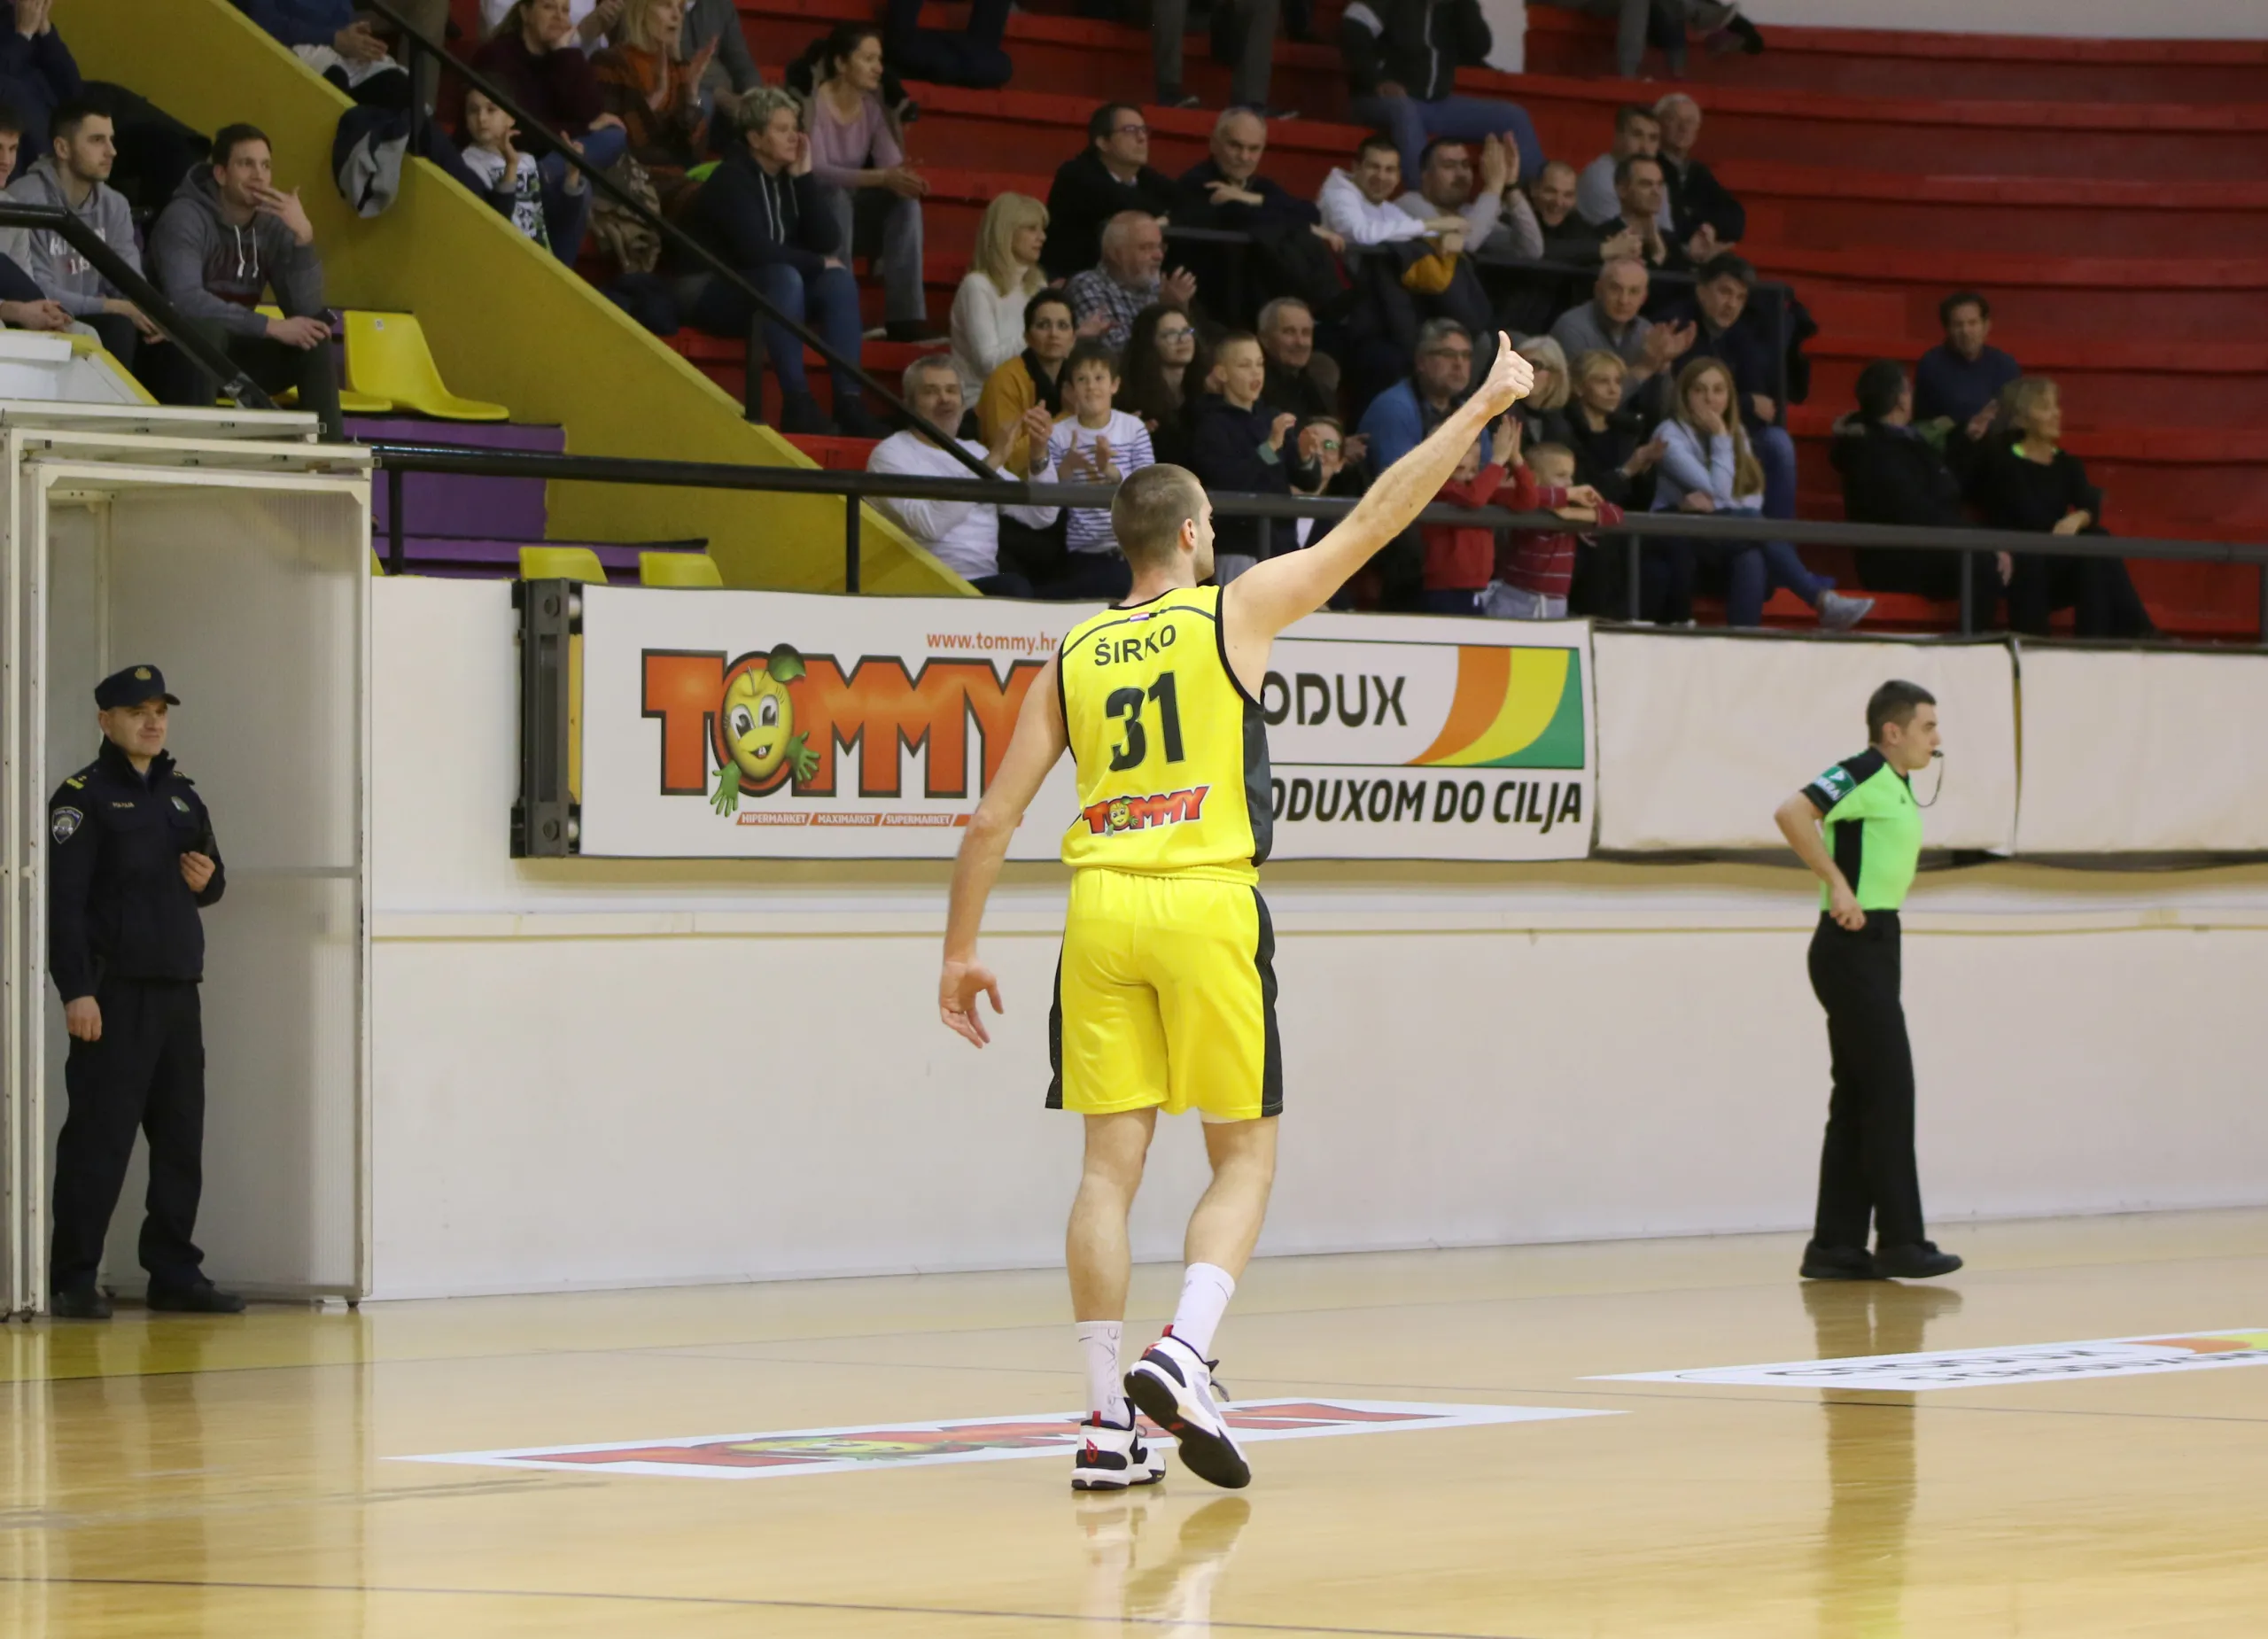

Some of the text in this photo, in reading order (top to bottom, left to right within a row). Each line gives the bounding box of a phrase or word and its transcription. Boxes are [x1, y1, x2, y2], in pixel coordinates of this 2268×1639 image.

[927, 632, 1058, 655] www.tommy.hr
[1094, 624, 1177, 666] ŠIRKO
[1105, 671, 1185, 772] 31
[742, 812, 950, 826] HIPERMARKET MAXIMARKET SUPERMARKET
[1083, 787, 1210, 835] TOMMY
[1432, 780, 1486, 823] DO
[1494, 781, 1581, 834] CILJA
